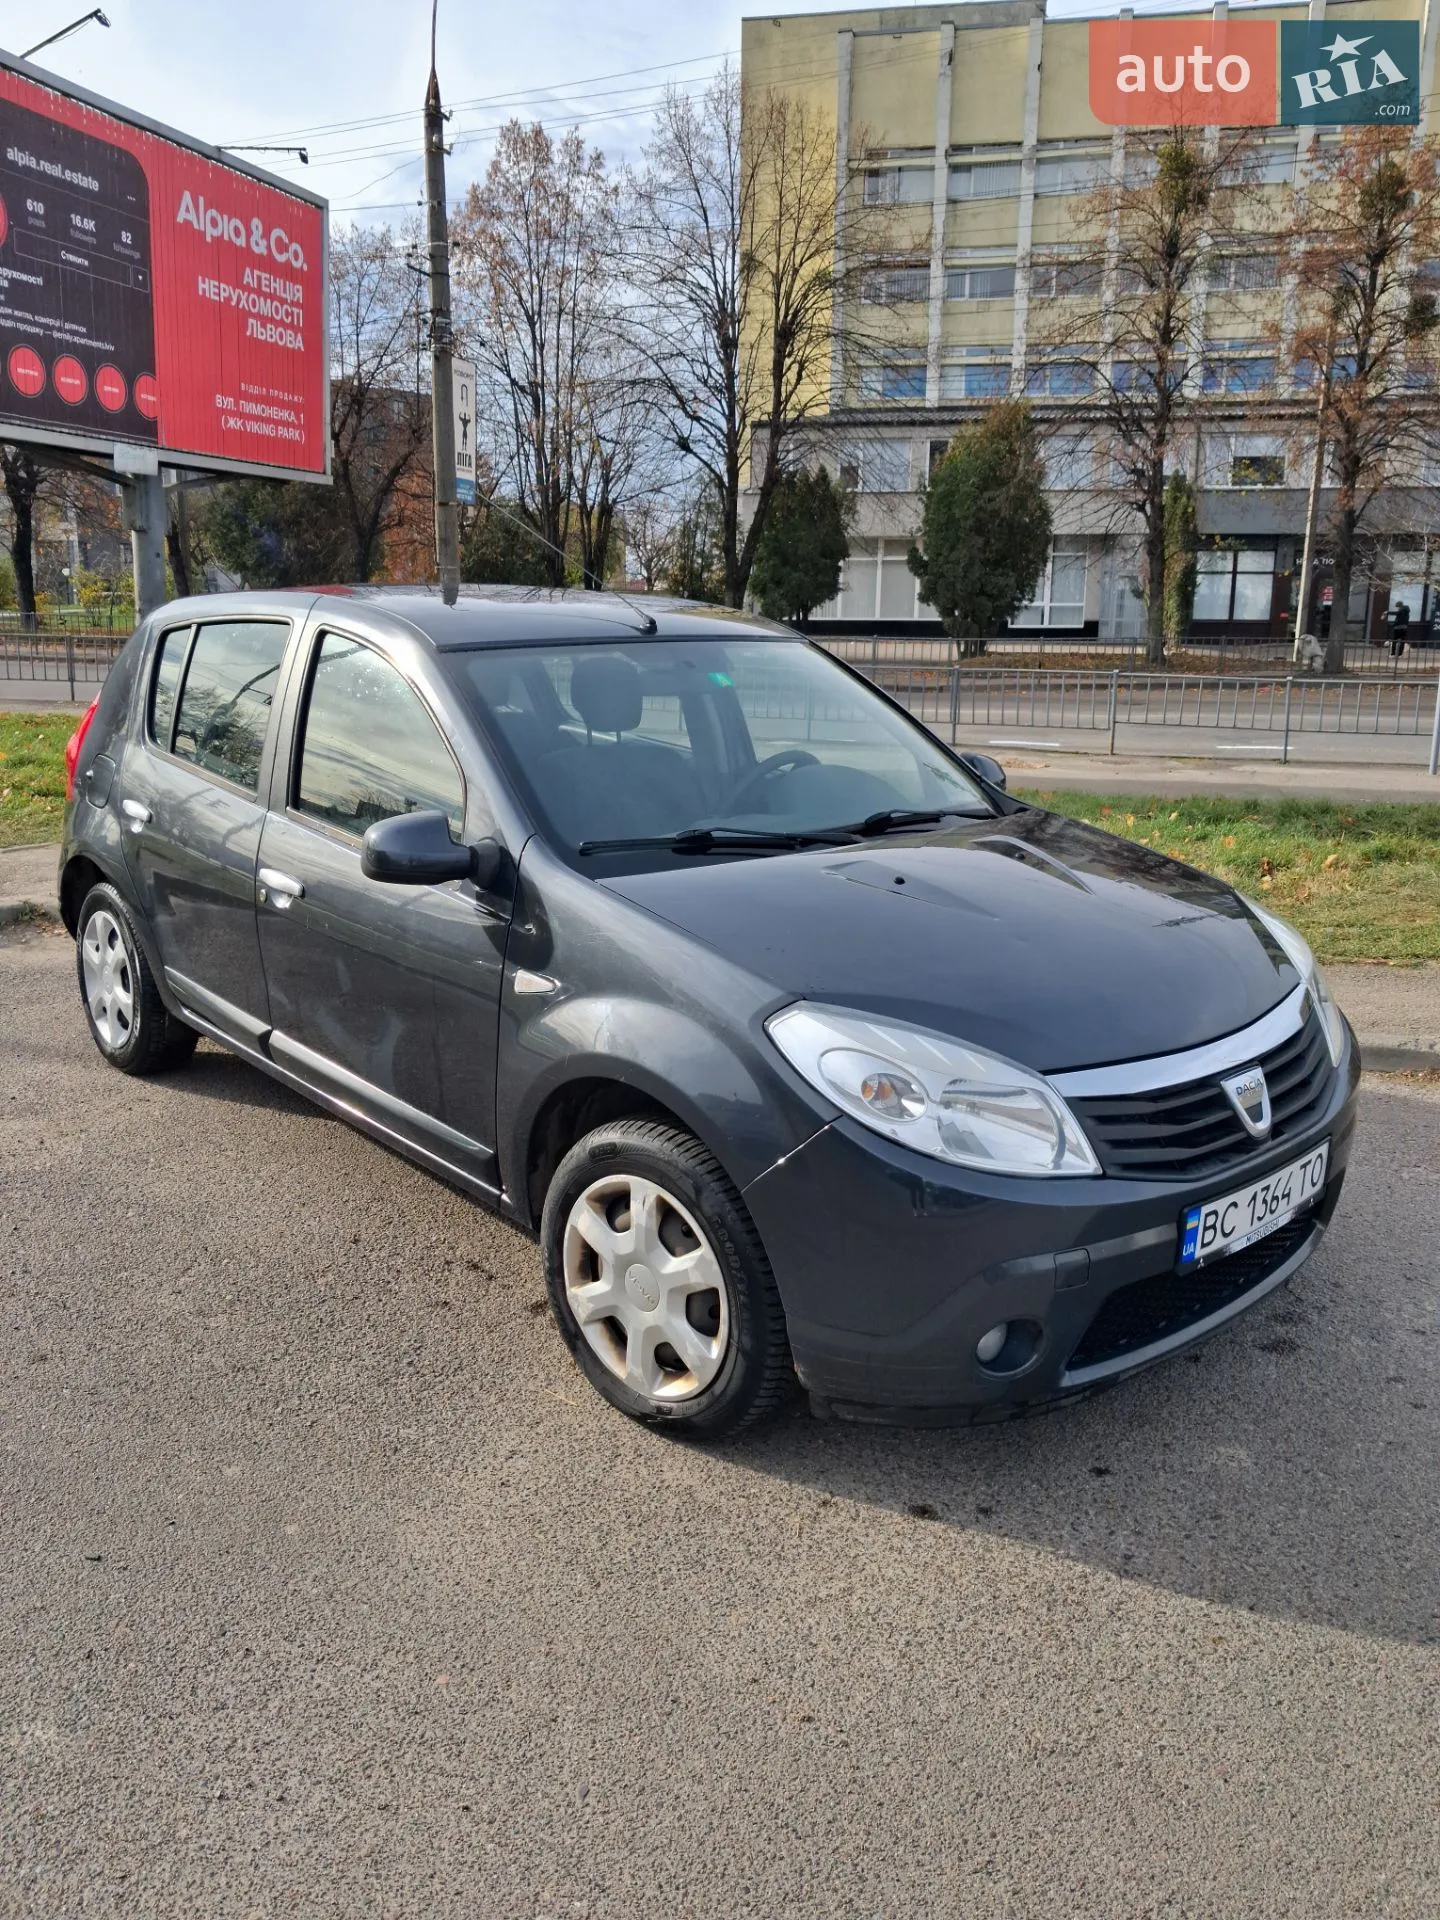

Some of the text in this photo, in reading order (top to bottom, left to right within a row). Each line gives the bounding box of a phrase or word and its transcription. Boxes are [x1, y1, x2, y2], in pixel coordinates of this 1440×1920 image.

[6, 147, 99, 191] alpia.real.estate
[26, 198, 44, 215] 610
[121, 231, 132, 244] 82
[177, 190, 308, 271] Alpia & Co.
[198, 275, 303, 327] НЕРУХОМОСТІ
[243, 267, 303, 304] АГЕНЦІЯ
[246, 318, 304, 351] ЛЬВОВА
[215, 394, 236, 411] ВУЛ.
[299, 413, 304, 425] 1
[245, 420, 276, 437] VIKING
[1236, 1078, 1263, 1096] DACIA
[1200, 1152, 1323, 1249] BC 1364 TO
[1182, 1243, 1195, 1256] UA
